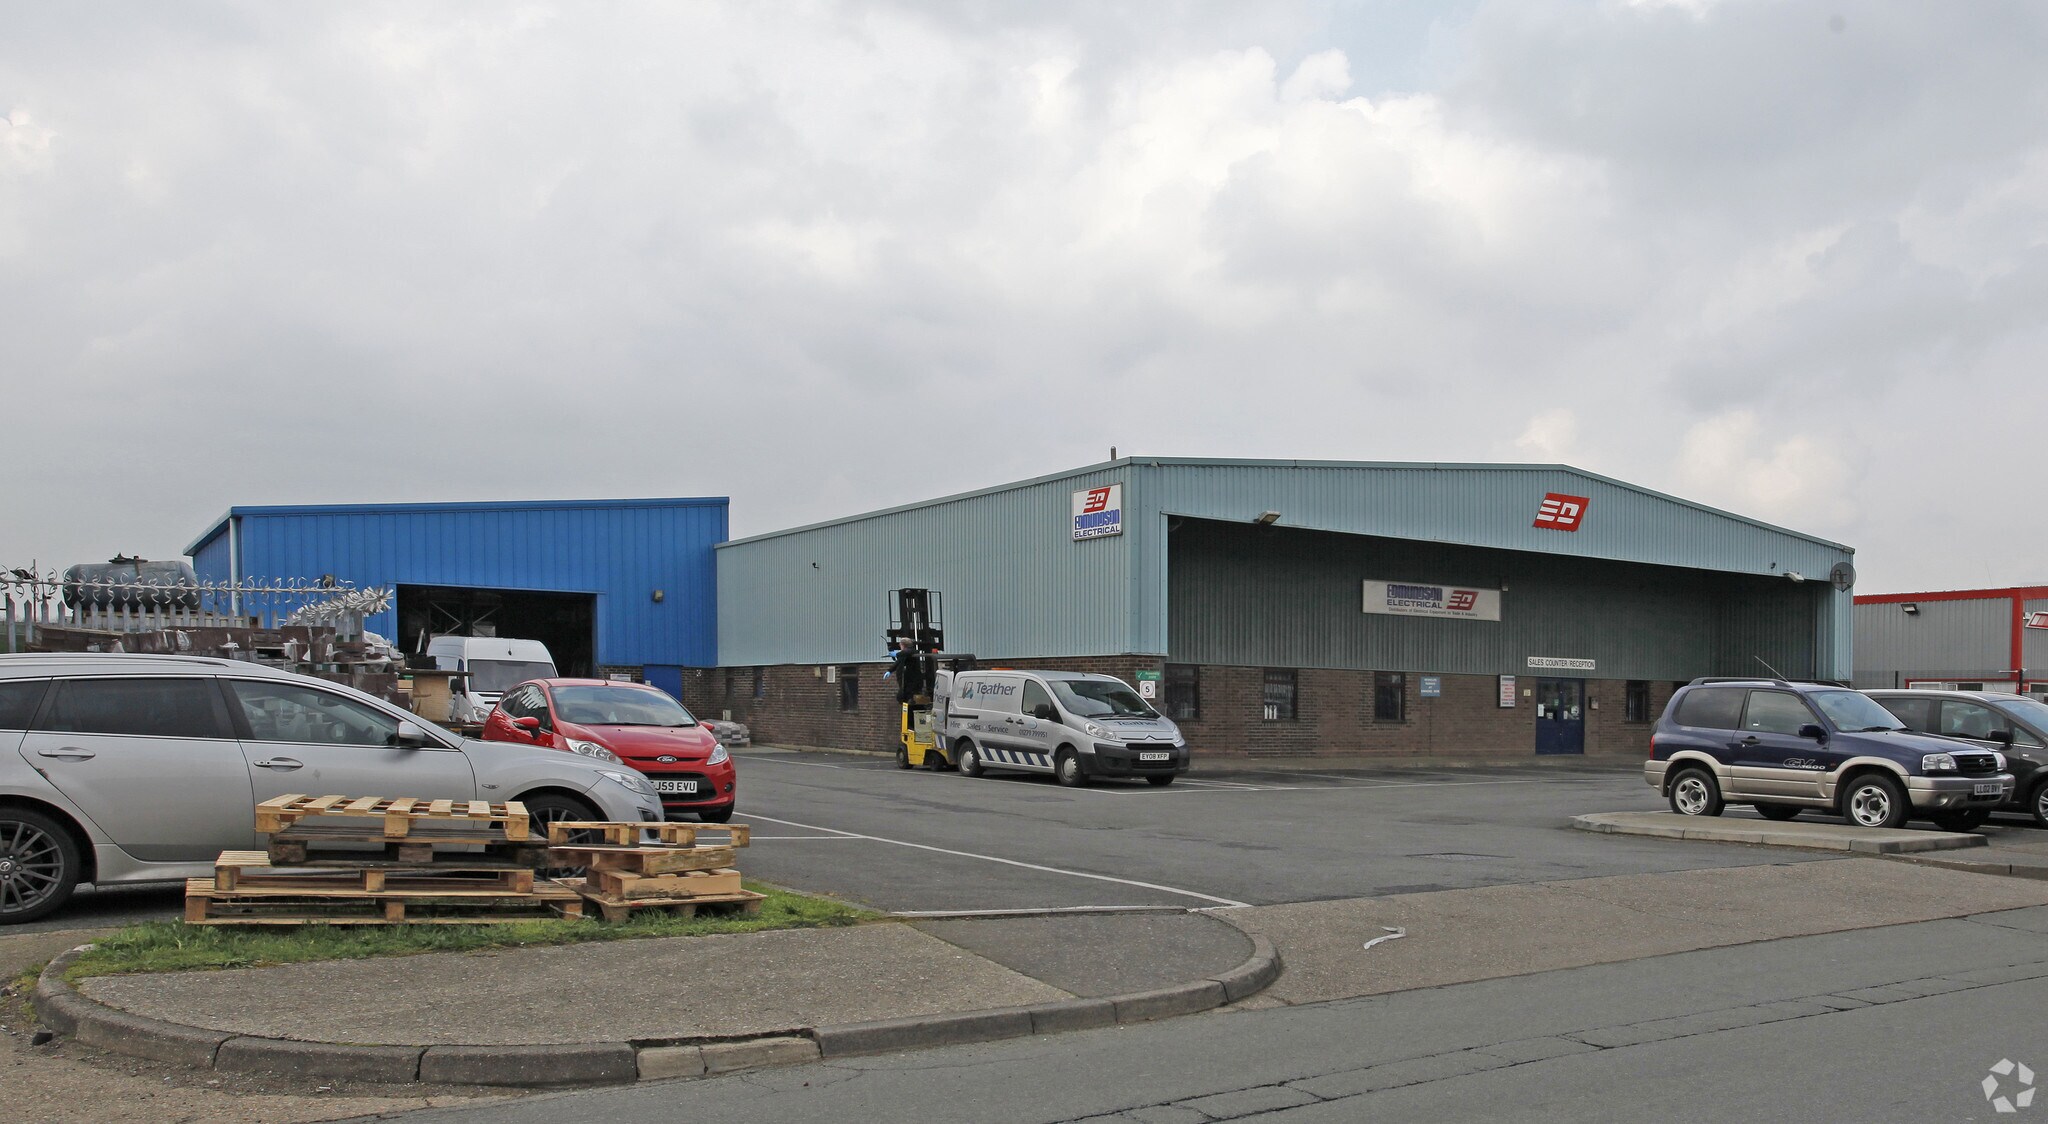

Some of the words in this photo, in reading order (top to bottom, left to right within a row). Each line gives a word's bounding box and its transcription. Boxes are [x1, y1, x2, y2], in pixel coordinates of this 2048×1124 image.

[1075, 525, 1120, 538] ELECTRICAL
[1387, 584, 1443, 602] EDMUNDSON
[1387, 599, 1443, 609] ELECTRICAL
[1529, 658, 1544, 666] SALES
[977, 682, 1016, 696] Teather
[1145, 685, 1151, 693] 5
[967, 722, 981, 731] Sales
[988, 724, 1009, 734] Service
[677, 781, 696, 791] EVU
